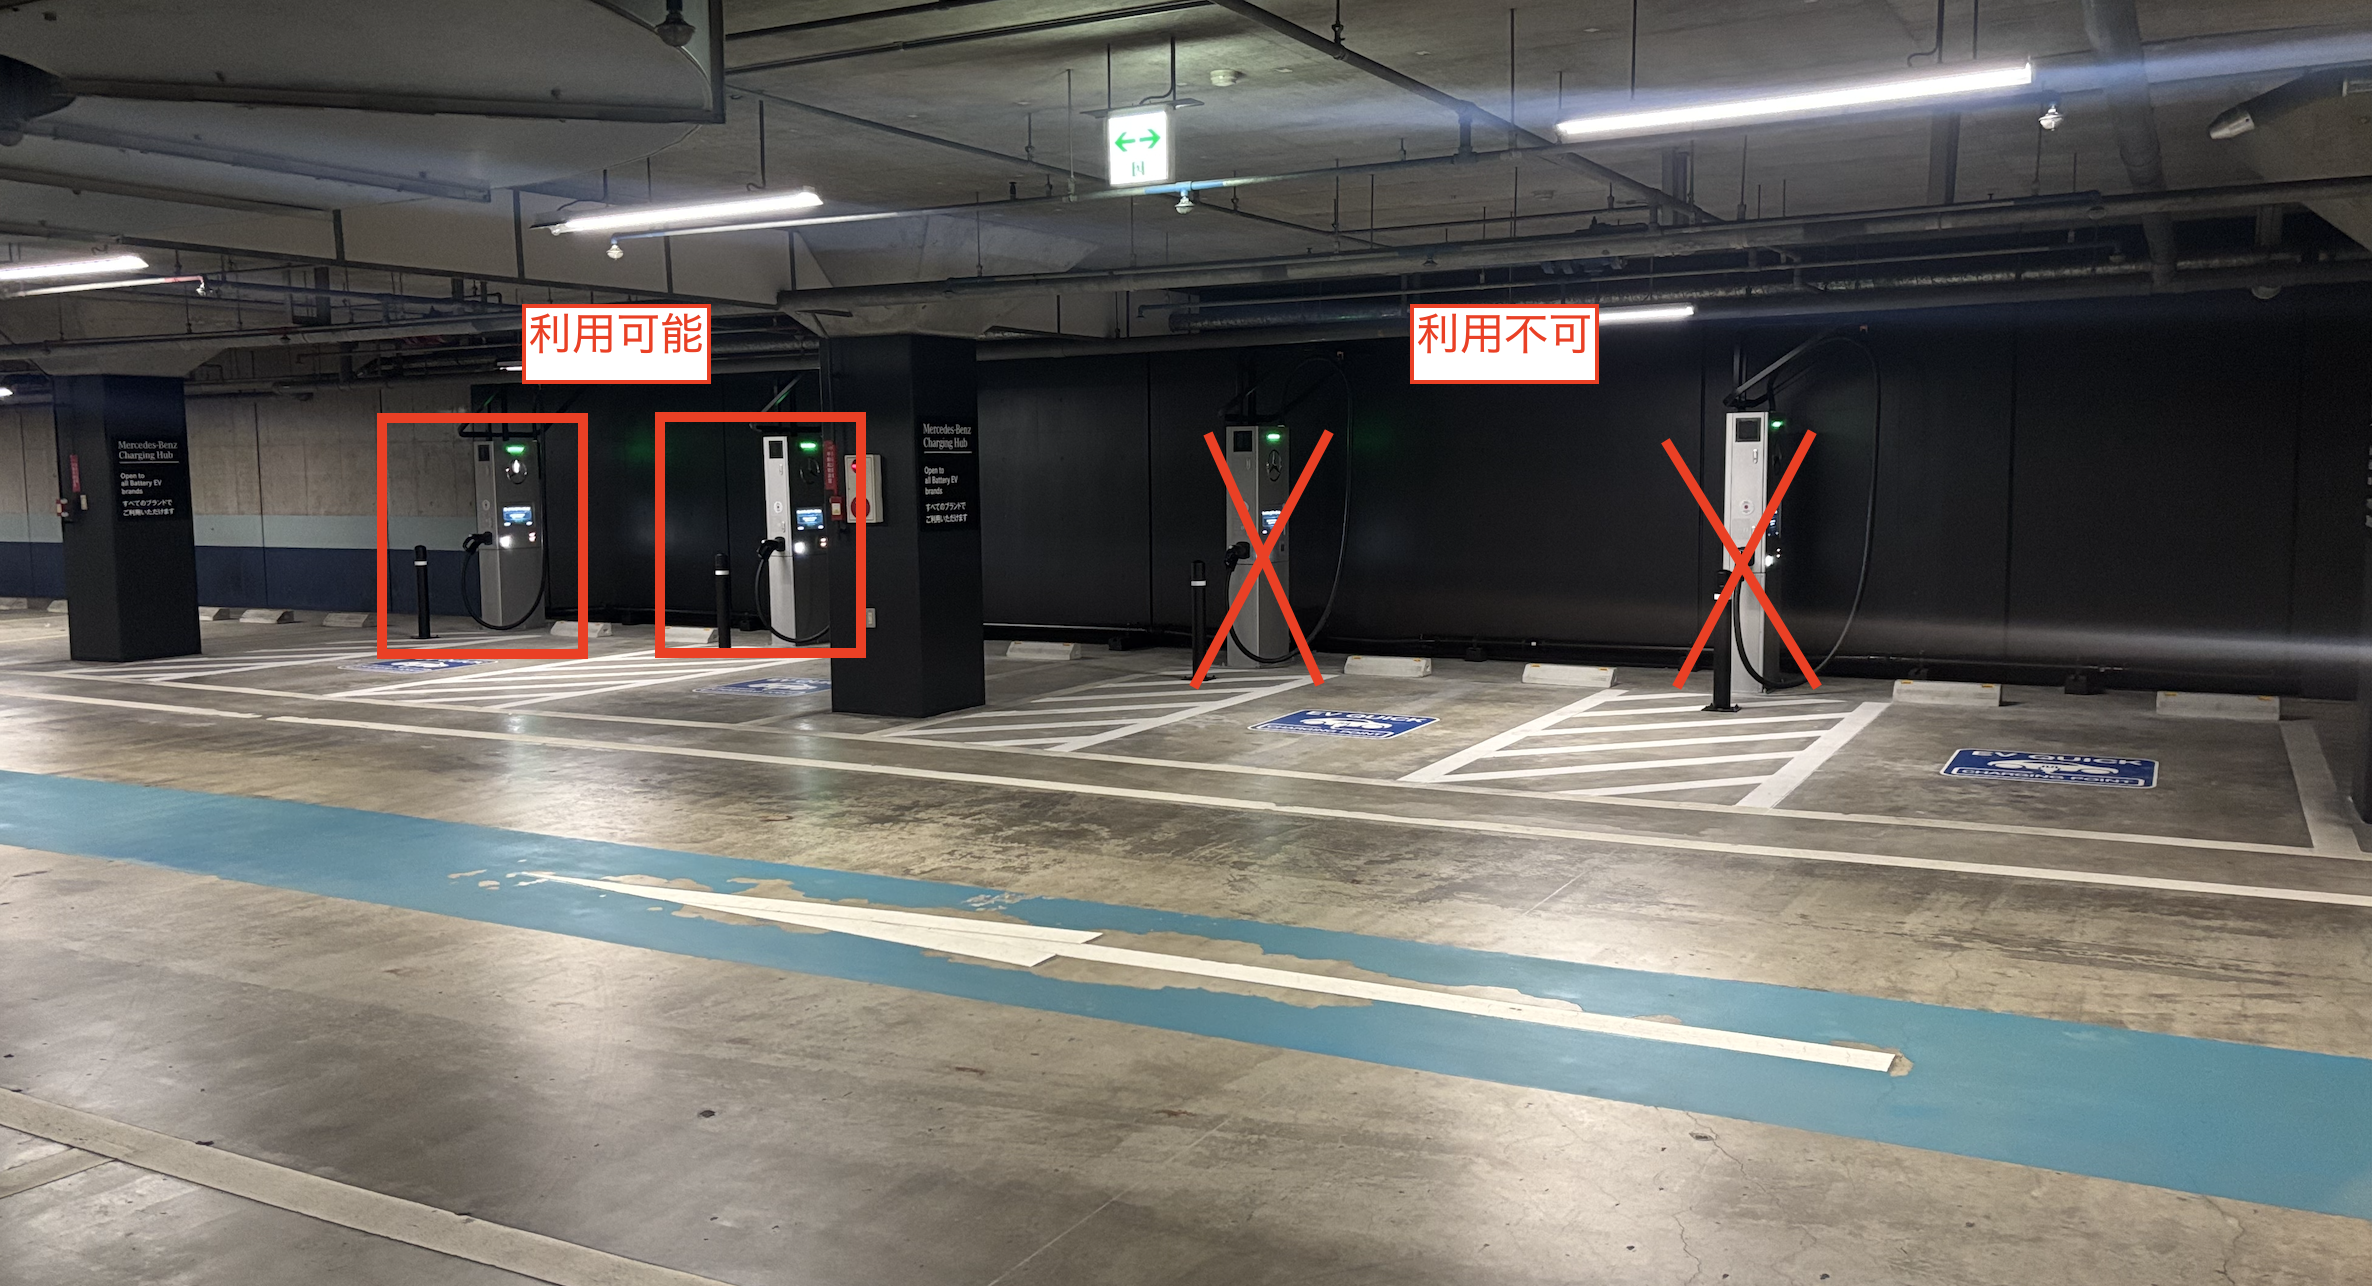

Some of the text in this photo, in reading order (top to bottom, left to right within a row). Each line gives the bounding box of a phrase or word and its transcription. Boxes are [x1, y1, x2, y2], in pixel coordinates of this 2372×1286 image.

[923, 423, 971, 434] Mercedes-Benz
[118, 441, 178, 449] Mercedes-Benz
[923, 437, 968, 450] Charging Hub
[119, 451, 174, 460] Charging Hub
[924, 466, 938, 475] Open
[932, 476, 950, 485] Battery
[951, 475, 958, 483] EV
[925, 487, 943, 495] brands
[122, 499, 173, 507] すべてのブランドで
[925, 502, 966, 512] すべてのブランドで
[1346, 713, 1427, 723] QUICK
[2028, 754, 2141, 765] QUICK
[1961, 769, 2135, 784] CHARGING POINT
